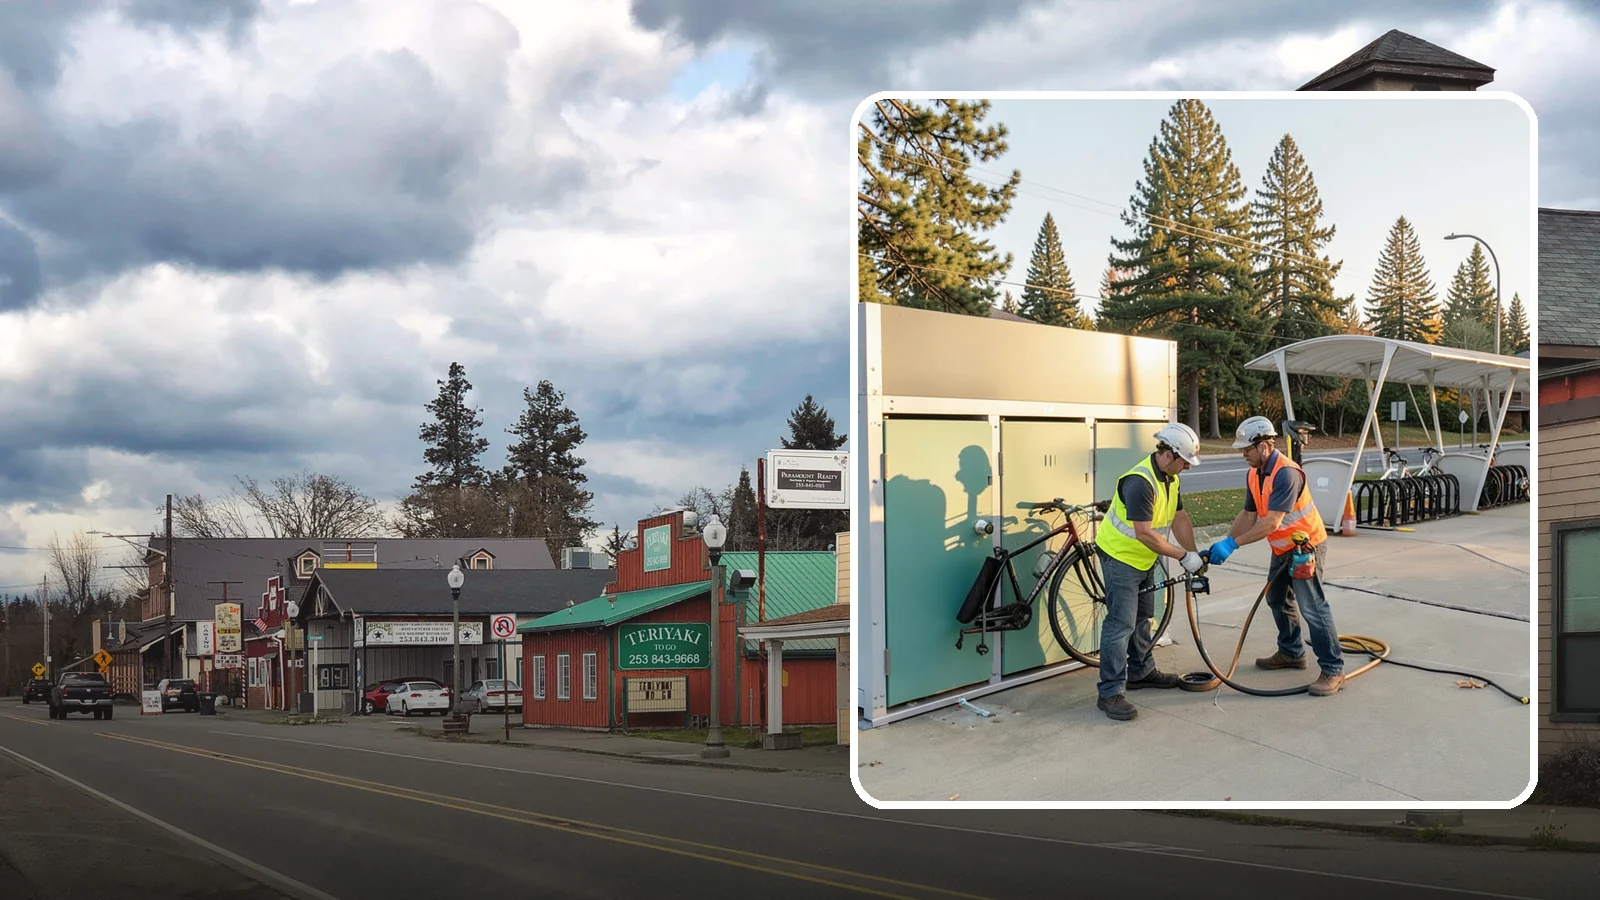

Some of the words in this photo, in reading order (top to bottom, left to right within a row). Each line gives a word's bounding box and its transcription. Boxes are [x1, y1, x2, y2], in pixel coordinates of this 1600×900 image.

[781, 471, 815, 479] PARAMOUNT
[817, 472, 839, 480] REALTY
[625, 627, 702, 646] TERIYAKI
[665, 643, 676, 651] GO
[629, 654, 649, 664] 253
[651, 653, 700, 664] 843-9668
